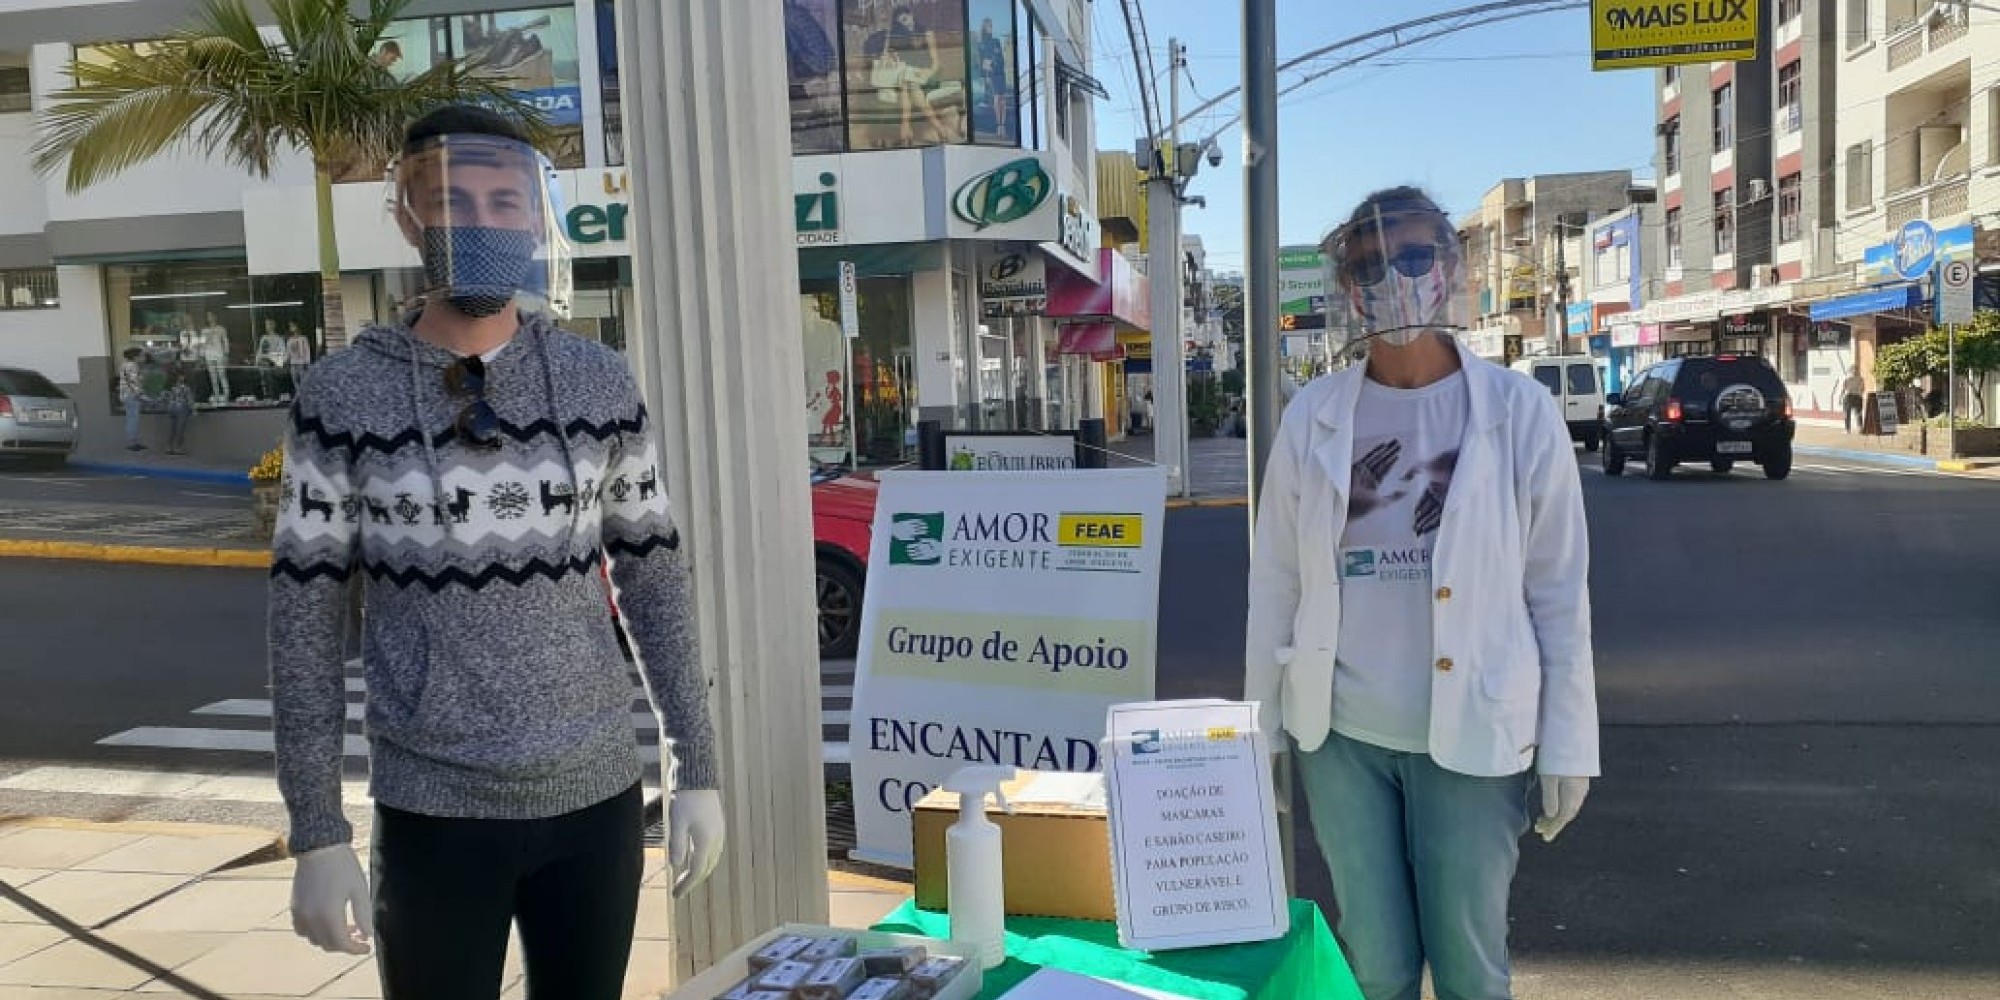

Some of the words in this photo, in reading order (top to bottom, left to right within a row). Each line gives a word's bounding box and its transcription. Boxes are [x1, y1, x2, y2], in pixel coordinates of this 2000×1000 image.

[1618, 3, 1688, 29] MAIS
[1693, 0, 1748, 24] LUX
[1952, 266, 1963, 281] E
[952, 511, 1051, 543] AMOR
[1075, 523, 1125, 539] FEAE
[949, 549, 1050, 570] EXIGENTE
[1379, 549, 1430, 564] AMOR
[887, 626, 973, 662] Grupo
[982, 630, 1018, 662] de
[1027, 635, 1129, 672] Apoio
[868, 717, 1102, 771] ENCANTAD
[879, 778, 943, 811] CO
[1156, 785, 1206, 801] DOAÇÃO
[1209, 785, 1224, 797] DE
[1146, 857, 1177, 870] PARA
[1180, 851, 1248, 868] POPULAÇÃO
[1156, 876, 1234, 892] VULNERÁVEL
[1153, 901, 1193, 916] GRUPO
[1195, 901, 1211, 913] DE
